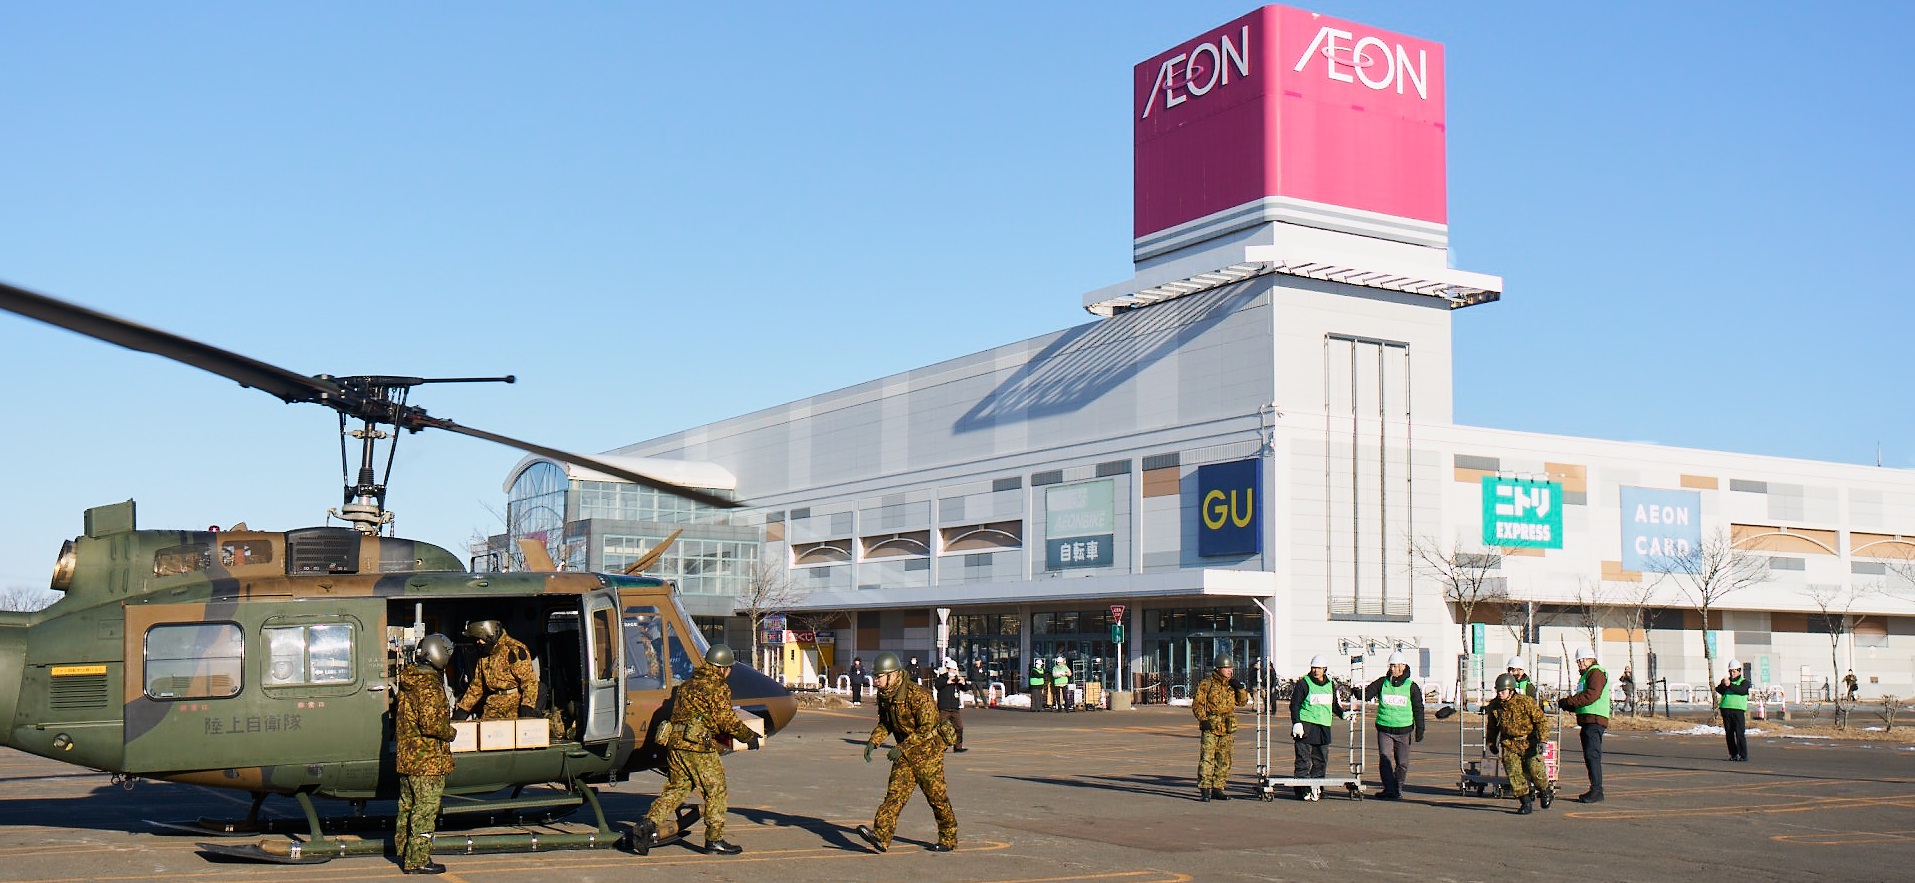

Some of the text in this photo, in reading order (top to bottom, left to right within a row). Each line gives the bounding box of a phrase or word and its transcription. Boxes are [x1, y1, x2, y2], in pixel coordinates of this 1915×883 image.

[1203, 488, 1253, 530] GU
[1495, 485, 1550, 517] ニトリ
[1635, 504, 1689, 526] AEON
[1496, 522, 1551, 541] EXPRESS
[1060, 541, 1099, 562] 自転車
[1635, 536, 1690, 557] CARD
[204, 714, 303, 735] 陸上自衛隊
